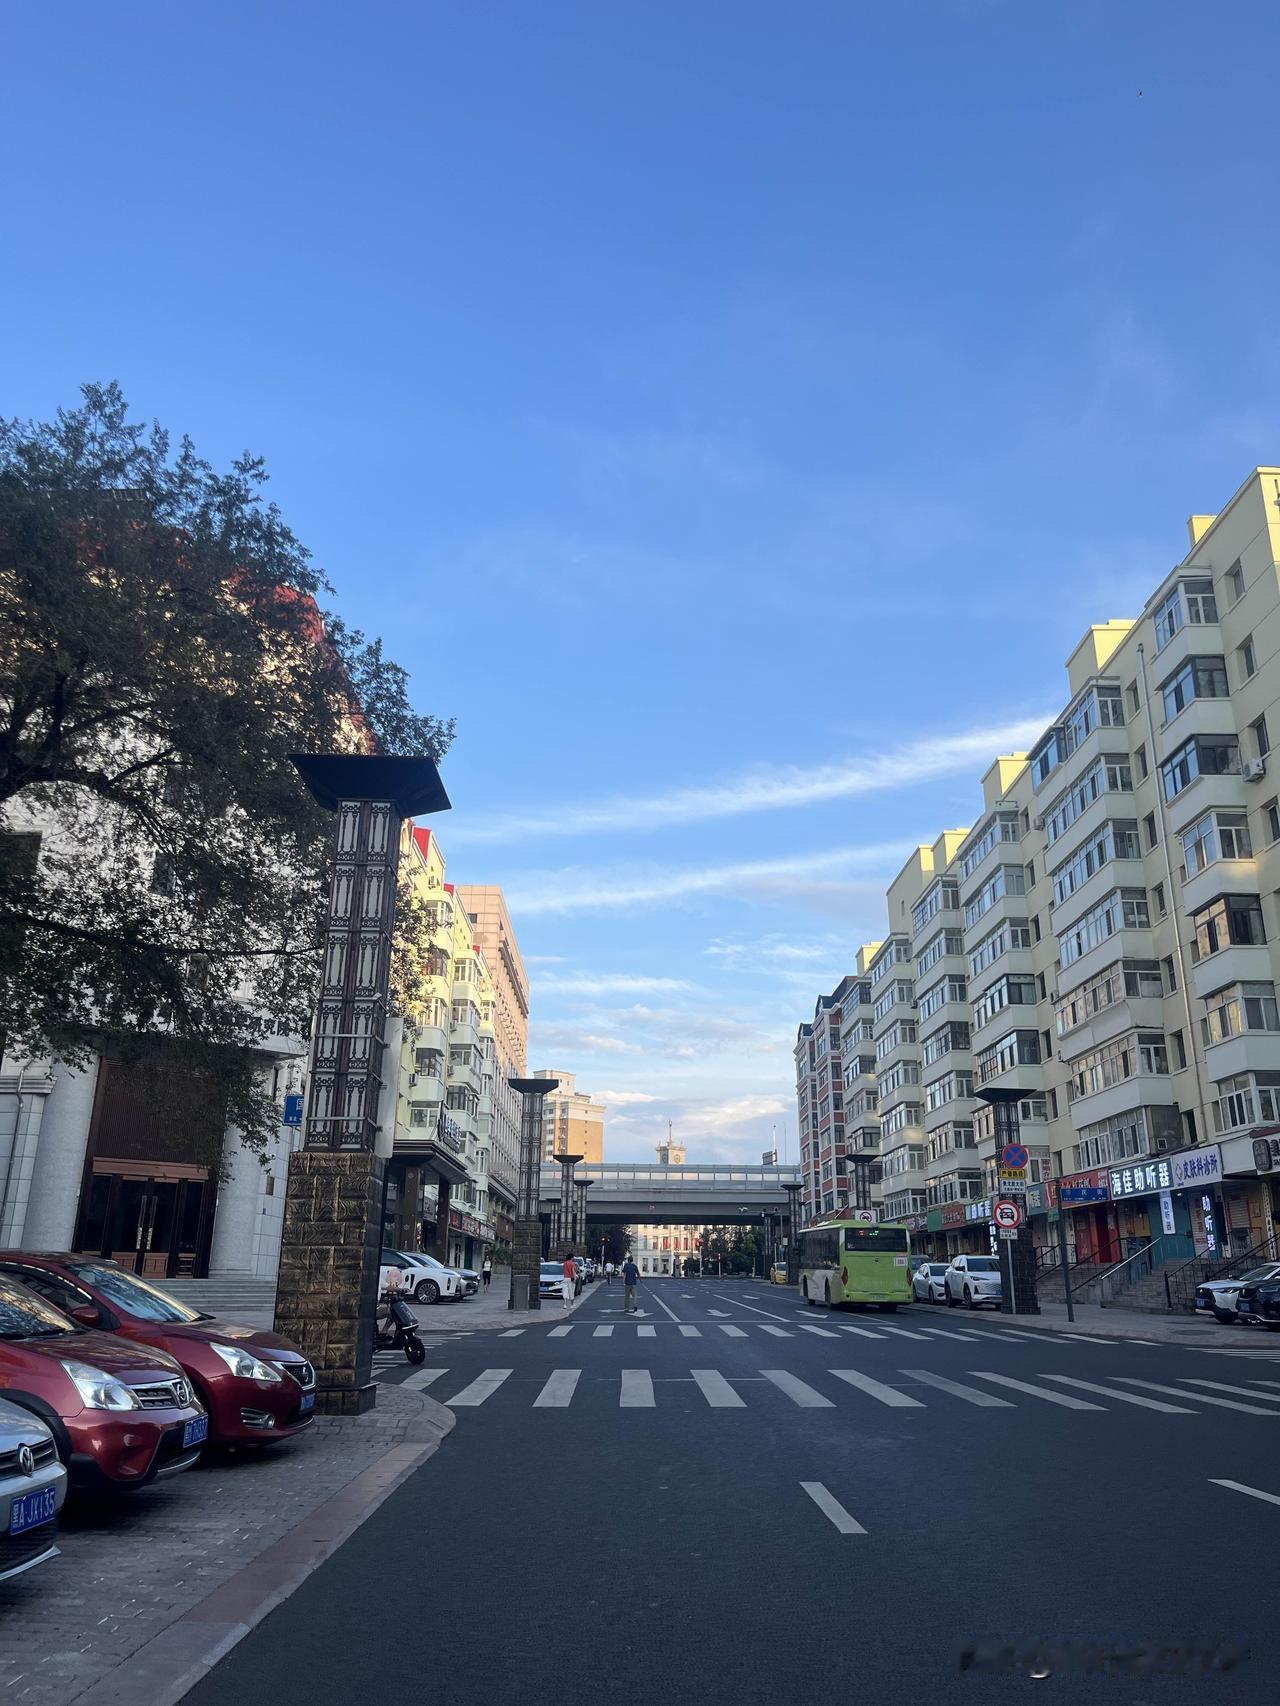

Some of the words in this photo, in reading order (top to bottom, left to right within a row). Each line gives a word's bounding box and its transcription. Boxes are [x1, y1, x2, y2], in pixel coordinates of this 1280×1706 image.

[1111, 1162, 1170, 1195] 海佳助听器
[1183, 1153, 1218, 1180] 皮肤科诊所
[1202, 1195, 1216, 1250] 助听器
